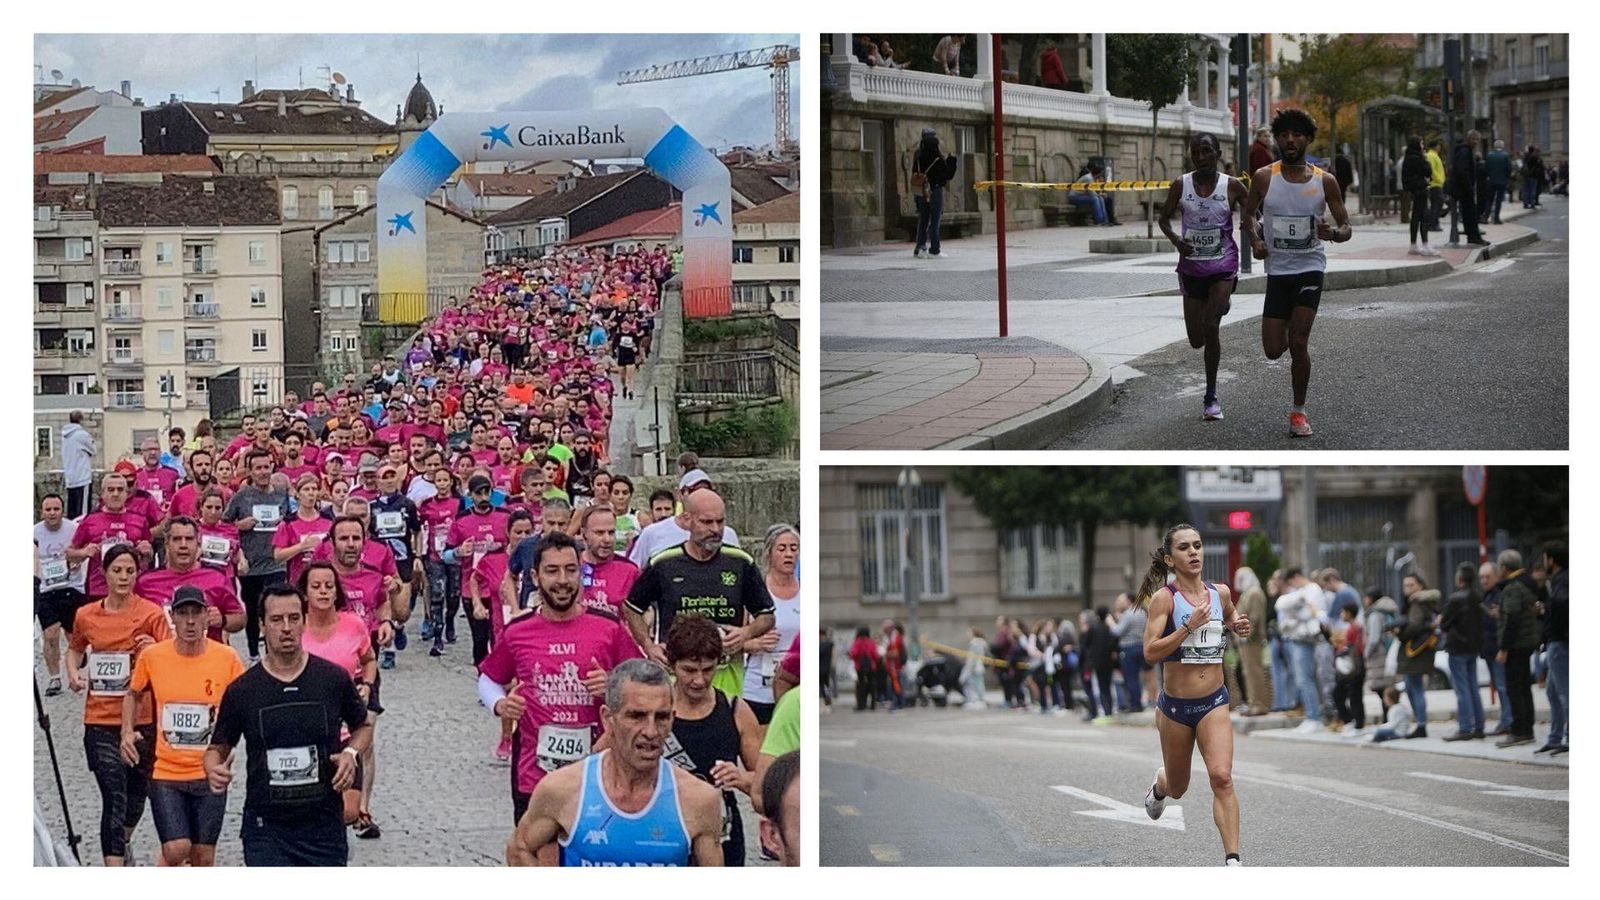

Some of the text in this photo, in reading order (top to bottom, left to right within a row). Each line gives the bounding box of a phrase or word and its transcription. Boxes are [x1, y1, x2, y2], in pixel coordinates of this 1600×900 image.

[518, 124, 625, 148] CaixaBank
[1288, 224, 1295, 236] 6
[1192, 235, 1214, 246] 1459
[1200, 629, 1207, 643] 11
[549, 643, 576, 655] XLVI
[97, 662, 122, 676] 2297
[539, 694, 594, 706] OURENSE
[173, 713, 201, 728] 1882
[552, 711, 579, 722] 2023
[548, 736, 583, 755] 2494
[279, 757, 298, 768] 7132
[582, 830, 608, 845] AXA
